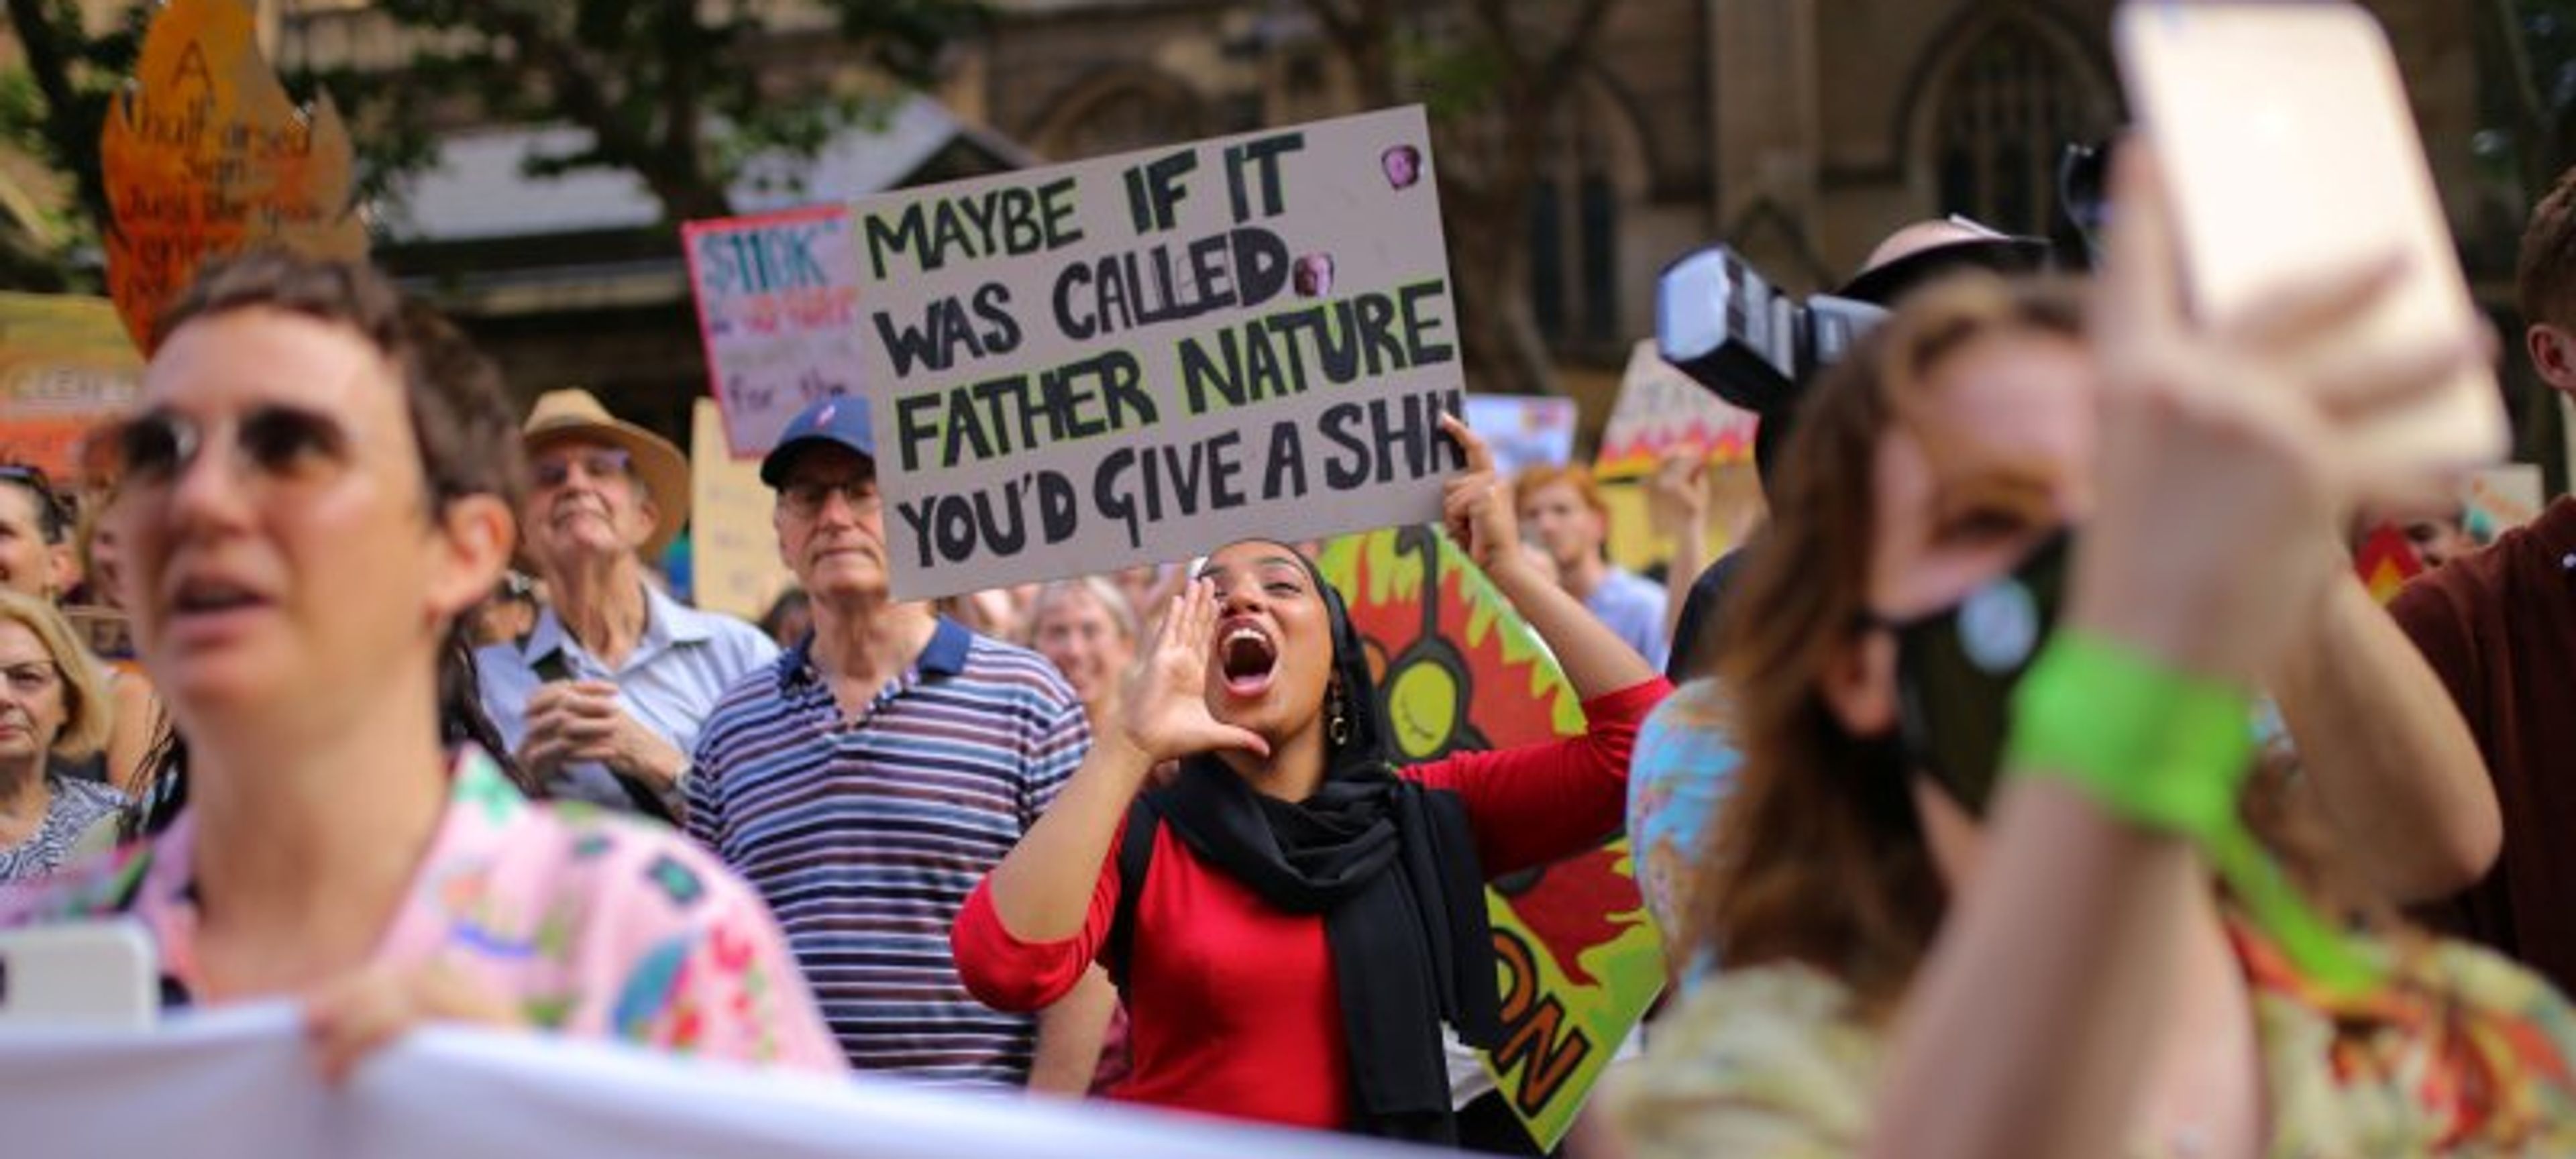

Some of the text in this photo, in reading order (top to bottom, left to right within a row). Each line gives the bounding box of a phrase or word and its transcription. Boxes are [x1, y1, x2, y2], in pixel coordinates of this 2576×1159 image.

[864, 133, 1304, 280] MAYBE IF IT
[873, 284, 1021, 378] WAS
[1053, 227, 1289, 340] CALLED
[896, 280, 1454, 472] FATHER NATURE
[898, 469, 1077, 567] YOU'D
[1093, 433, 1246, 548] GIVE
[1262, 421, 1307, 501] A
